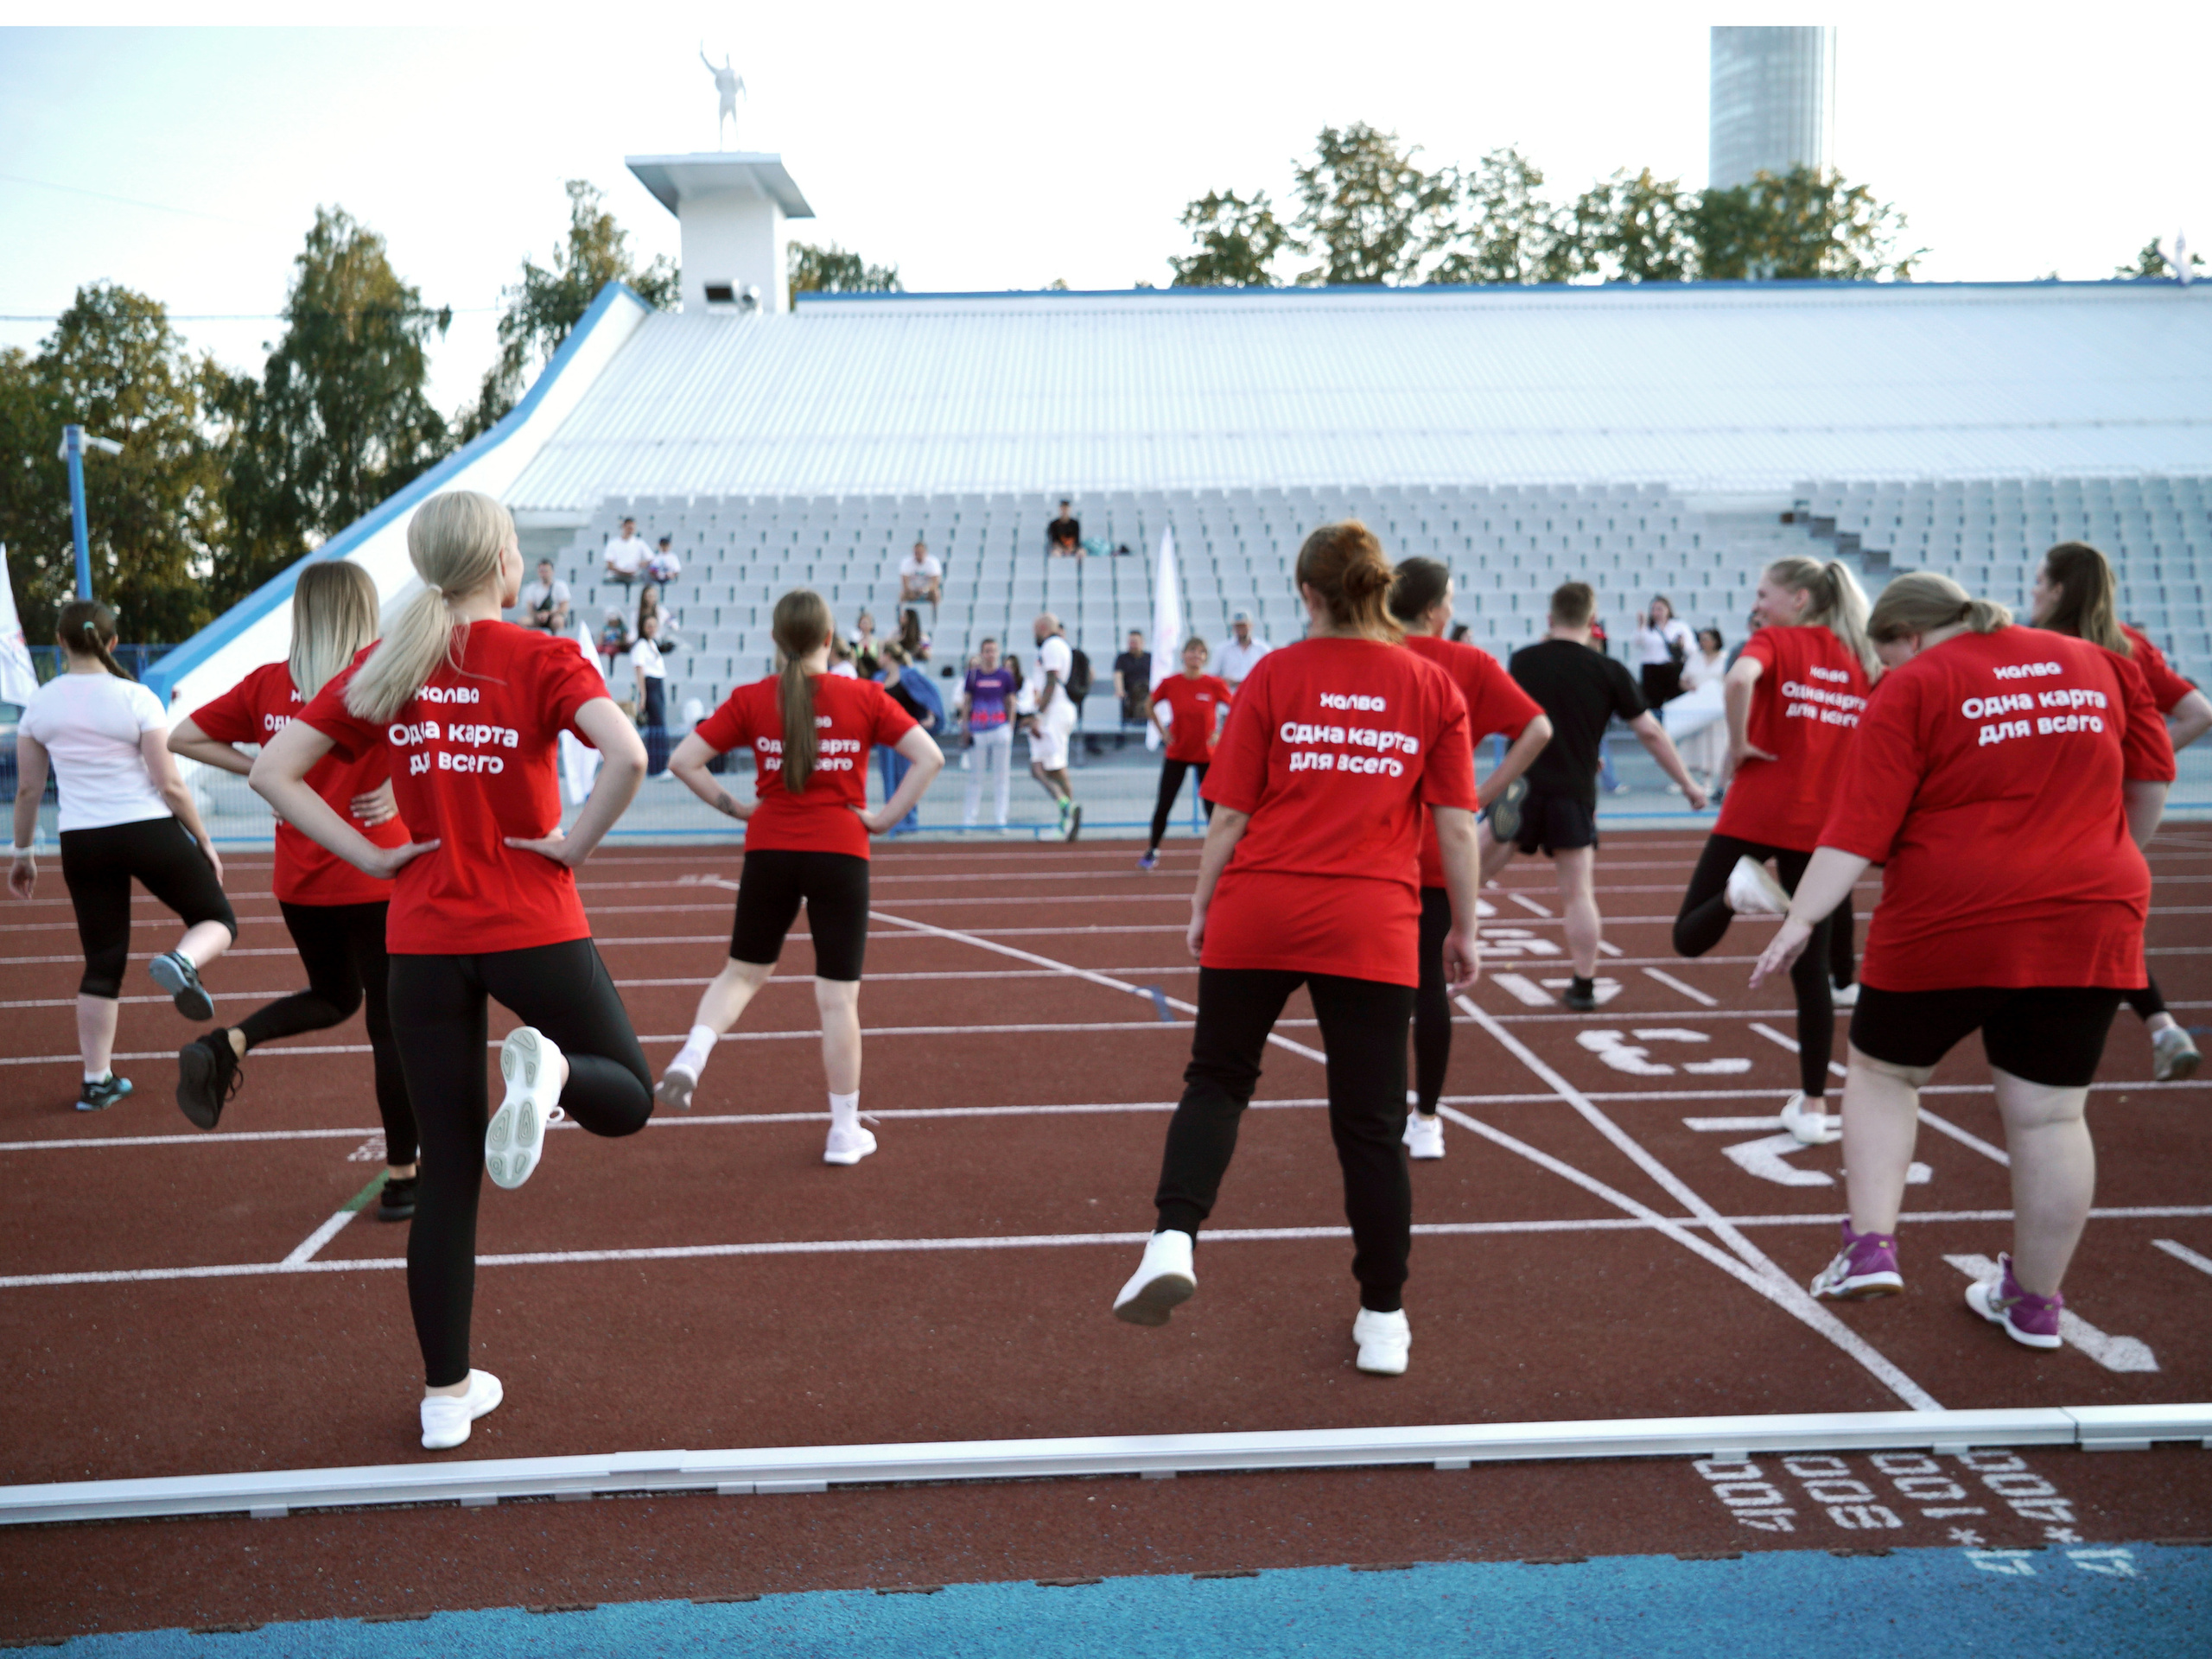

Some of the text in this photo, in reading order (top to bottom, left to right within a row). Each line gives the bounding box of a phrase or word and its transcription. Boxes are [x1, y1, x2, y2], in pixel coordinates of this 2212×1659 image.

[1961, 688, 2107, 720] Одна карта
[448, 723, 519, 748] карта
[1280, 721, 1421, 755] Одна карта
[1978, 714, 2103, 747] для всего
[817, 739, 861, 756] арта
[438, 751, 505, 774] всего
[1288, 751, 1405, 778] для всего
